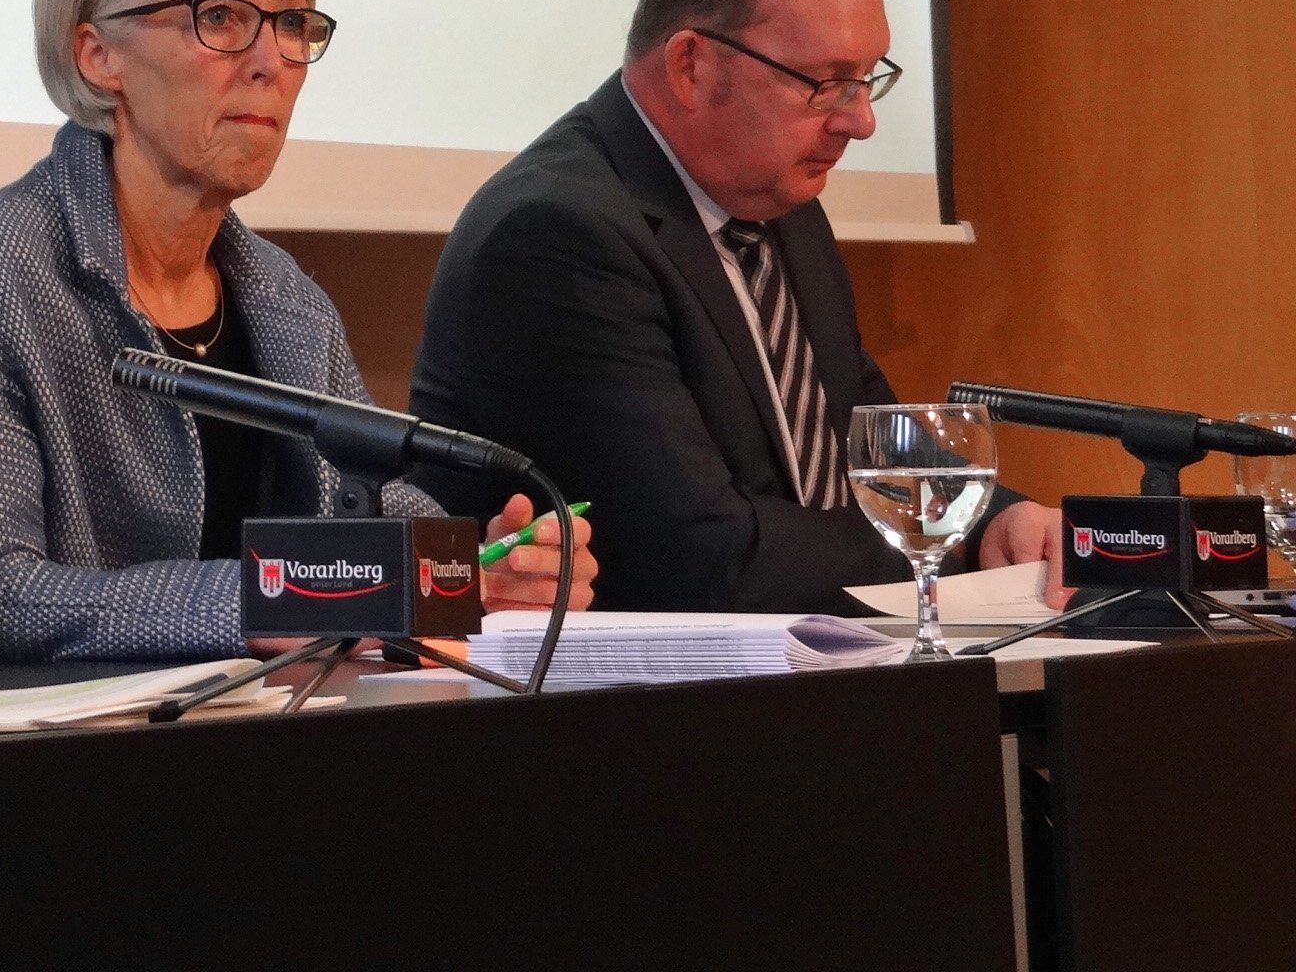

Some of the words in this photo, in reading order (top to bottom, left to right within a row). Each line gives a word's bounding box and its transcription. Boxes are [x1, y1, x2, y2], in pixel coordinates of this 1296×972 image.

[1093, 530, 1165, 550] Vorarlberg
[1209, 530, 1257, 549] Vorarlberg
[285, 559, 383, 584] Vorarlberg
[430, 559, 472, 583] Vorarlberg
